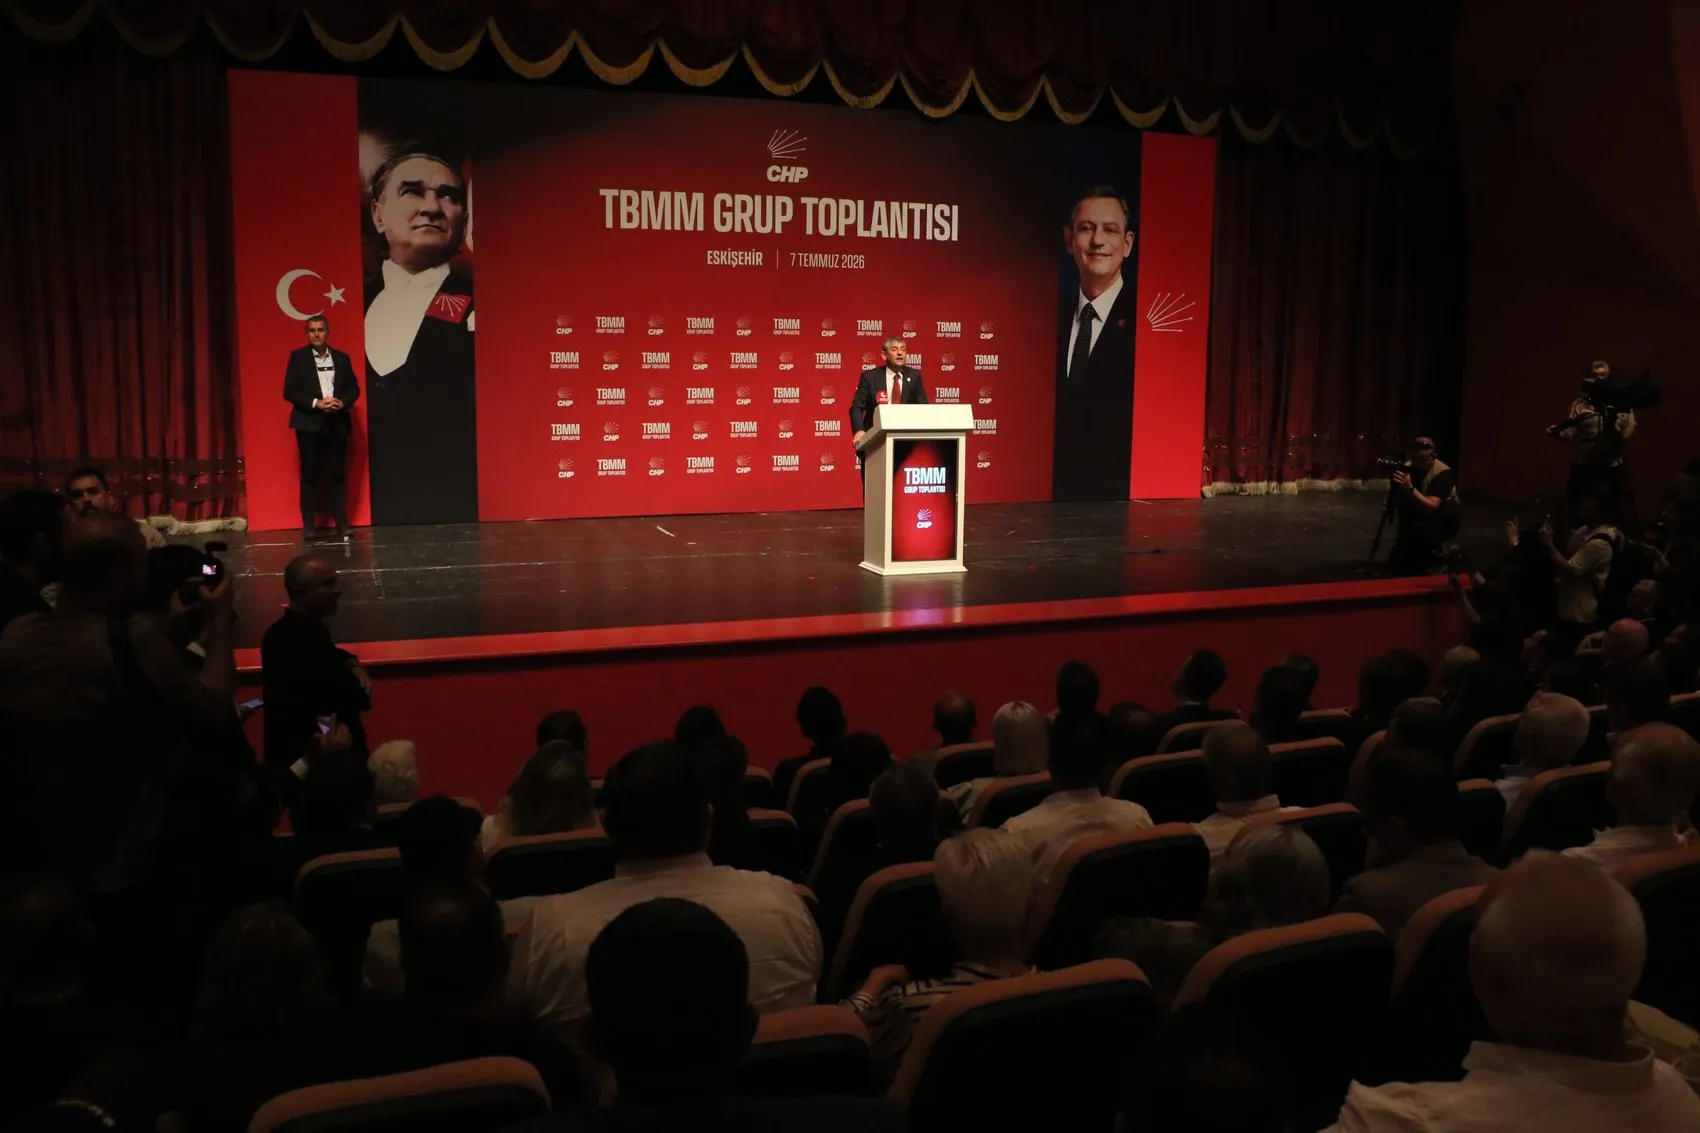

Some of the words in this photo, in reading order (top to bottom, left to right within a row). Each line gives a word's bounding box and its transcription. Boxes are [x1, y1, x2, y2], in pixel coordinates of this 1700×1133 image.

[766, 165, 808, 183] CHP
[599, 188, 704, 231] TBMM
[713, 193, 793, 234] GRUP
[801, 197, 959, 241] TOPLANTISI
[706, 248, 763, 268] ESKİŞEHİR
[790, 253, 796, 266] 7
[798, 253, 839, 268] TEMMUZ
[841, 254, 865, 269] 2026
[596, 316, 625, 328] TBMM
[686, 317, 714, 328] TBMM
[773, 319, 800, 330] TBMM
[857, 320, 882, 330] TBMM
[936, 322, 961, 332] TBMM
[550, 352, 579, 364] TBMM
[642, 352, 670, 364] TBMM
[730, 352, 757, 364] TBMM
[815, 353, 841, 364] TBMM
[906, 354, 921, 364] MM
[974, 355, 998, 366] TBMM
[597, 388, 625, 400] TBMM
[687, 388, 714, 398] TBMM
[772, 387, 799, 398] TBMM
[936, 387, 959, 398] TBMM
[551, 424, 580, 436] TBMM
[643, 422, 670, 434] TBMM
[730, 421, 757, 432] TBMM
[815, 420, 840, 430] TBMM
[973, 419, 996, 430] TBMM
[598, 459, 626, 470] TBMM
[687, 457, 714, 468] TBMM
[772, 455, 799, 466] TBMM
[904, 467, 946, 484] TBMM
